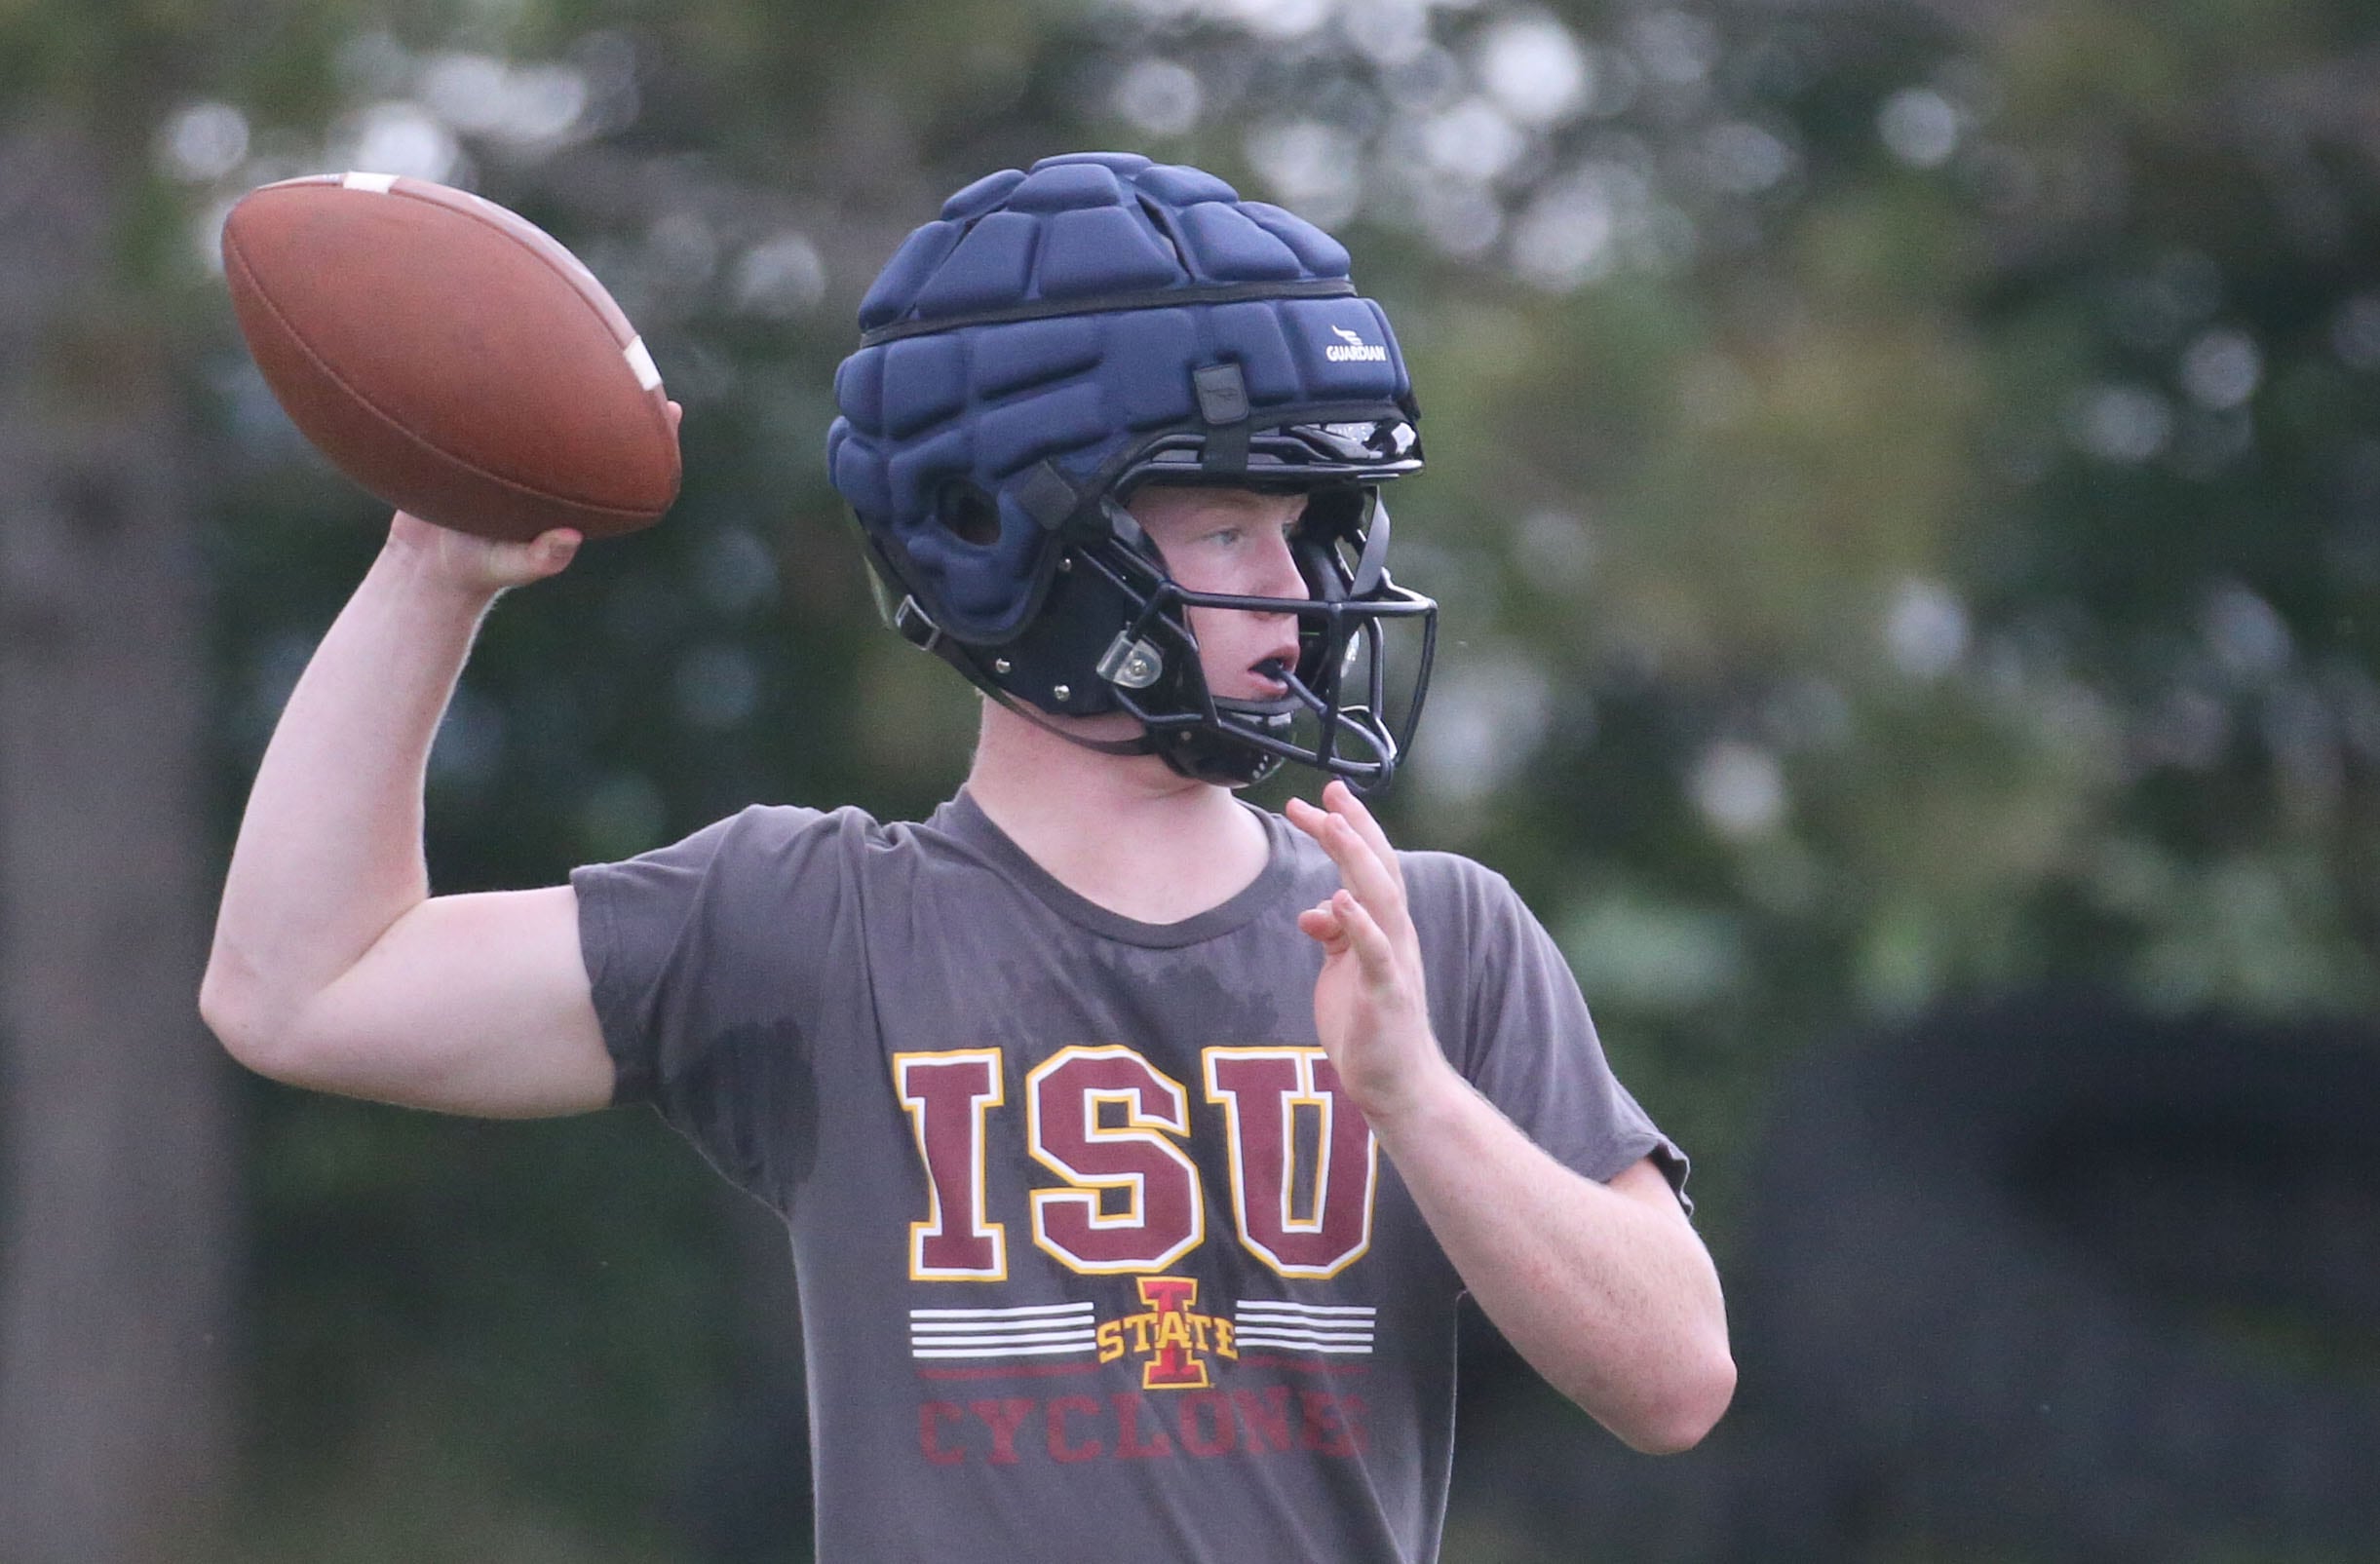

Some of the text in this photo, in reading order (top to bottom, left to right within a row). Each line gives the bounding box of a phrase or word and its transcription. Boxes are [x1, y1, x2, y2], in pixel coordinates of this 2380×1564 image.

[1325, 345, 1386, 362] GUARDIAN
[894, 1045, 1379, 1281] ISU
[1096, 1312, 1239, 1364] STATE
